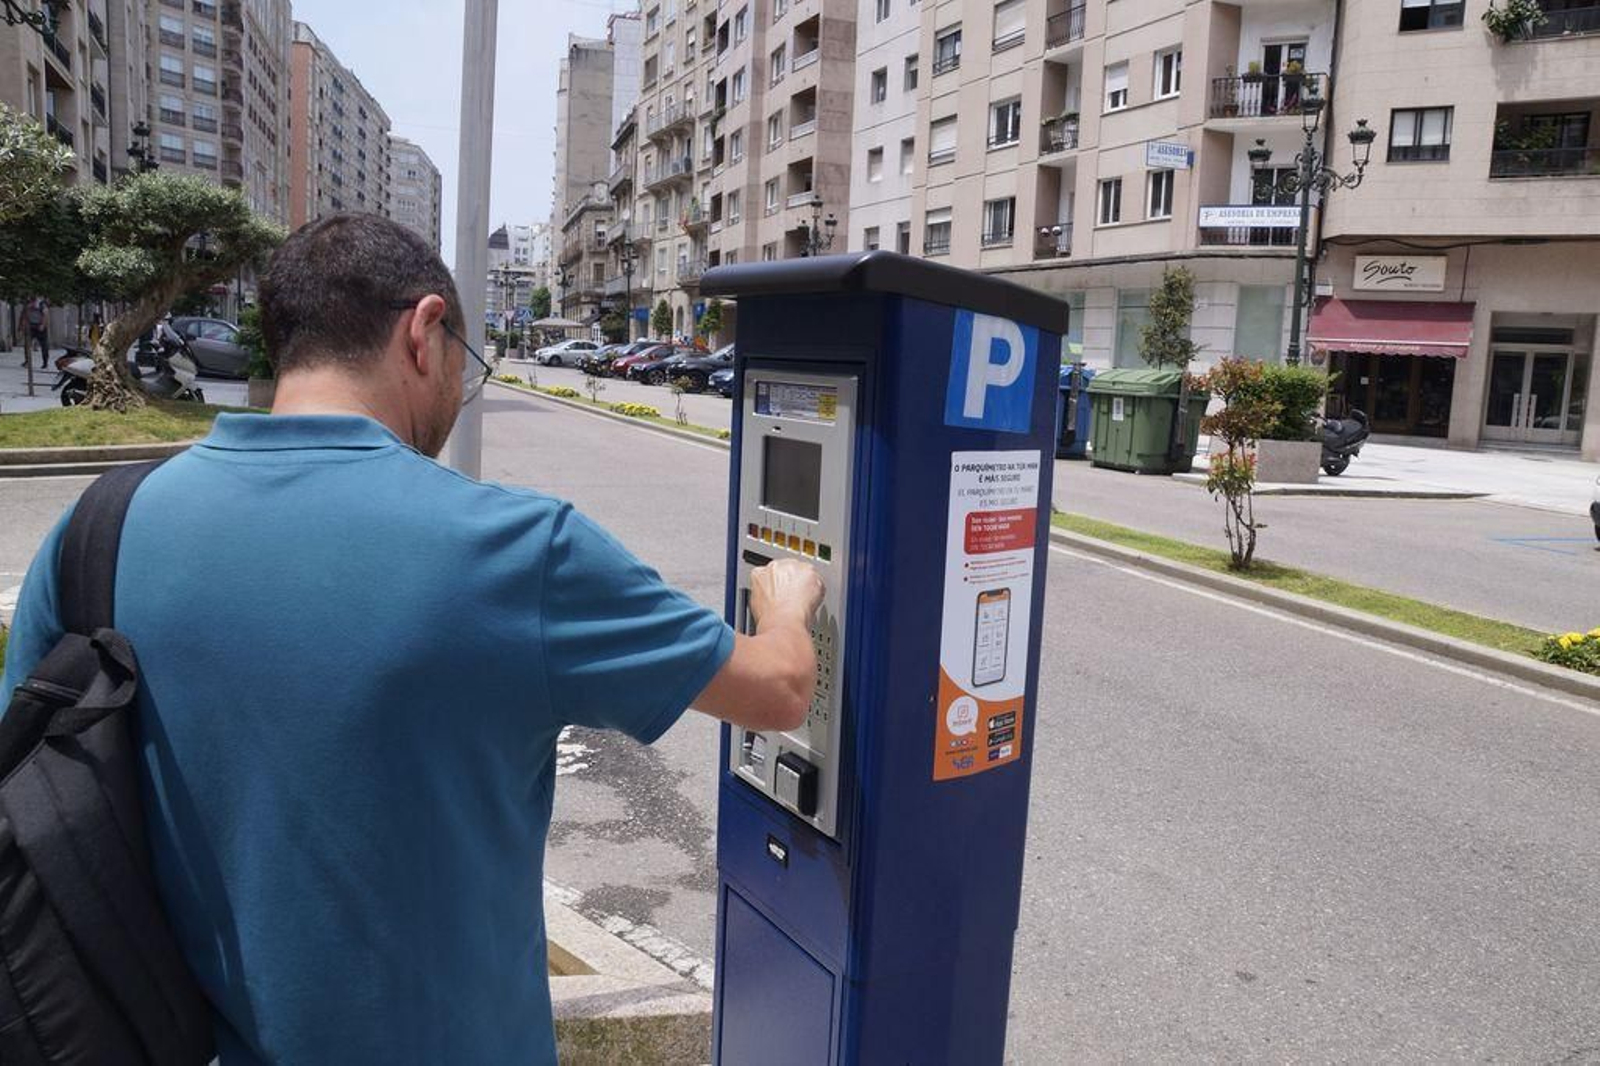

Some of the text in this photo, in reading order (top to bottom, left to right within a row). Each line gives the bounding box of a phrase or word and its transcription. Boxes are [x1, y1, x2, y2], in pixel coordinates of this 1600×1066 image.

[1363, 260, 1418, 281] Souto
[963, 312, 1025, 419] P
[954, 464, 960, 473] O
[1001, 473, 1021, 482] SEGURO
